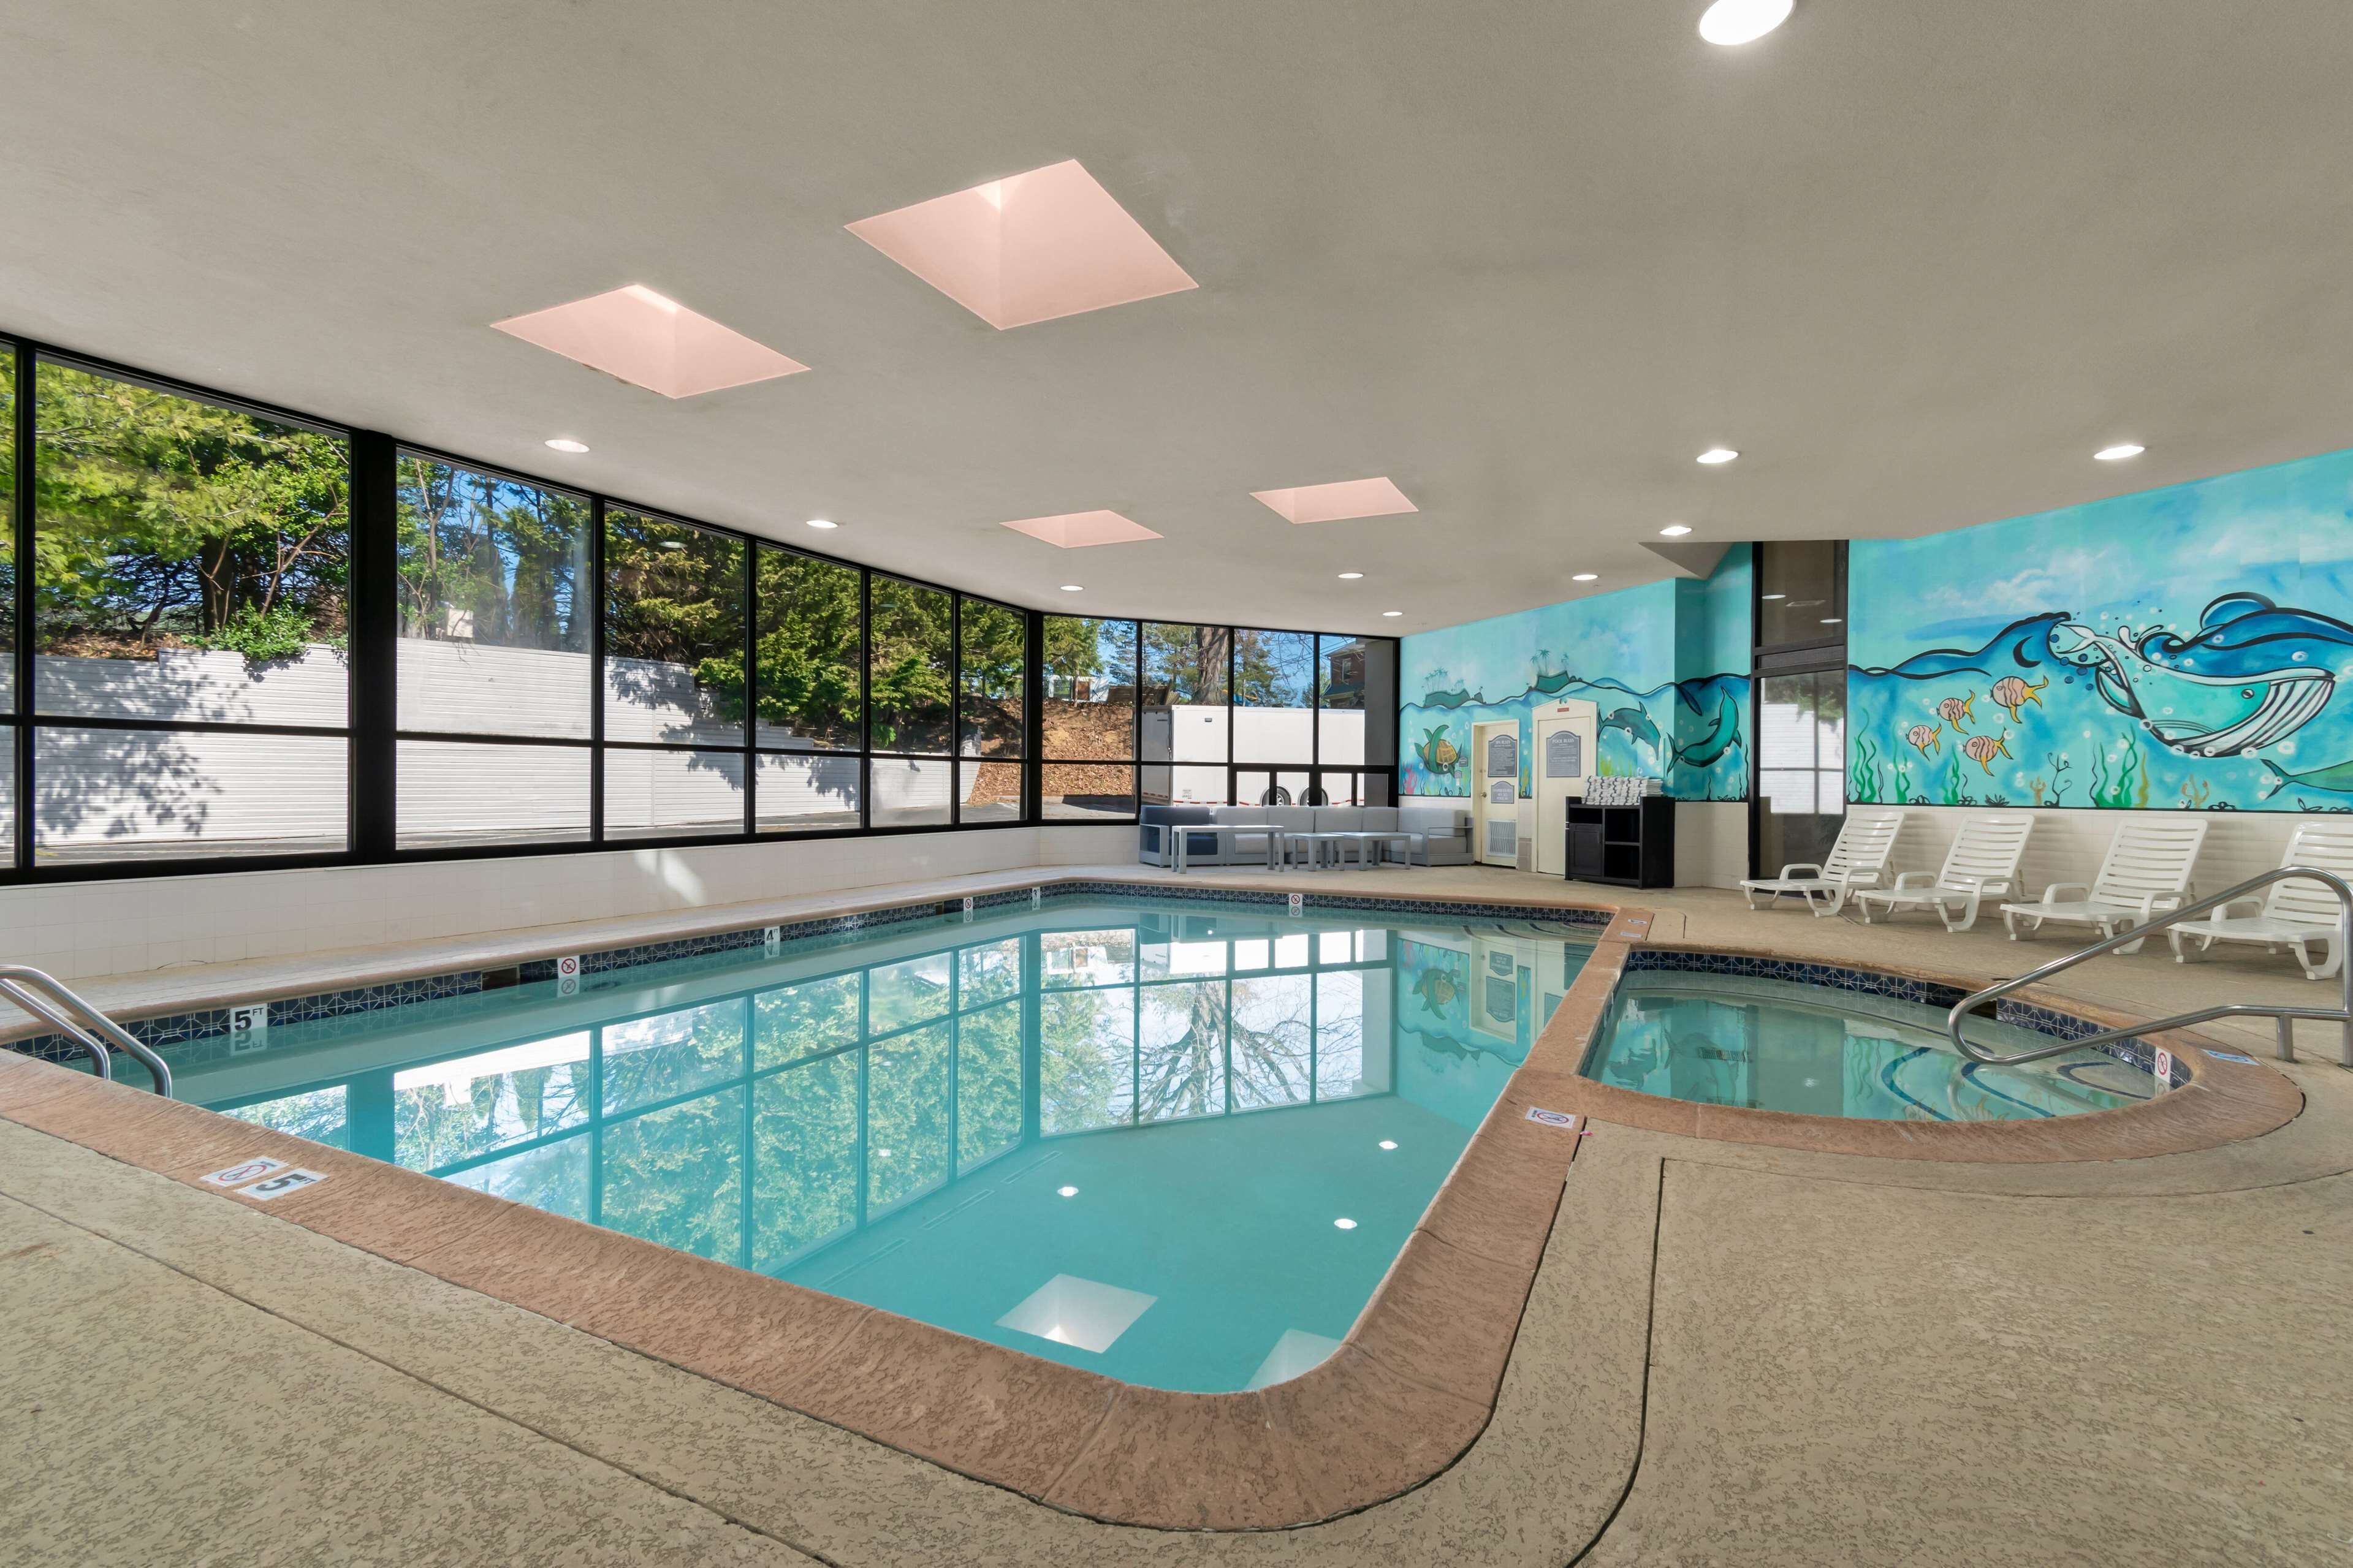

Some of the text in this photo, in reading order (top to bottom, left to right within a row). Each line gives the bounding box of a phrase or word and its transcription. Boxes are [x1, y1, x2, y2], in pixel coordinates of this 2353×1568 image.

[766, 930, 774, 941] 4
[235, 1007, 264, 1031] 5 FT
[256, 1173, 308, 1191] 5
